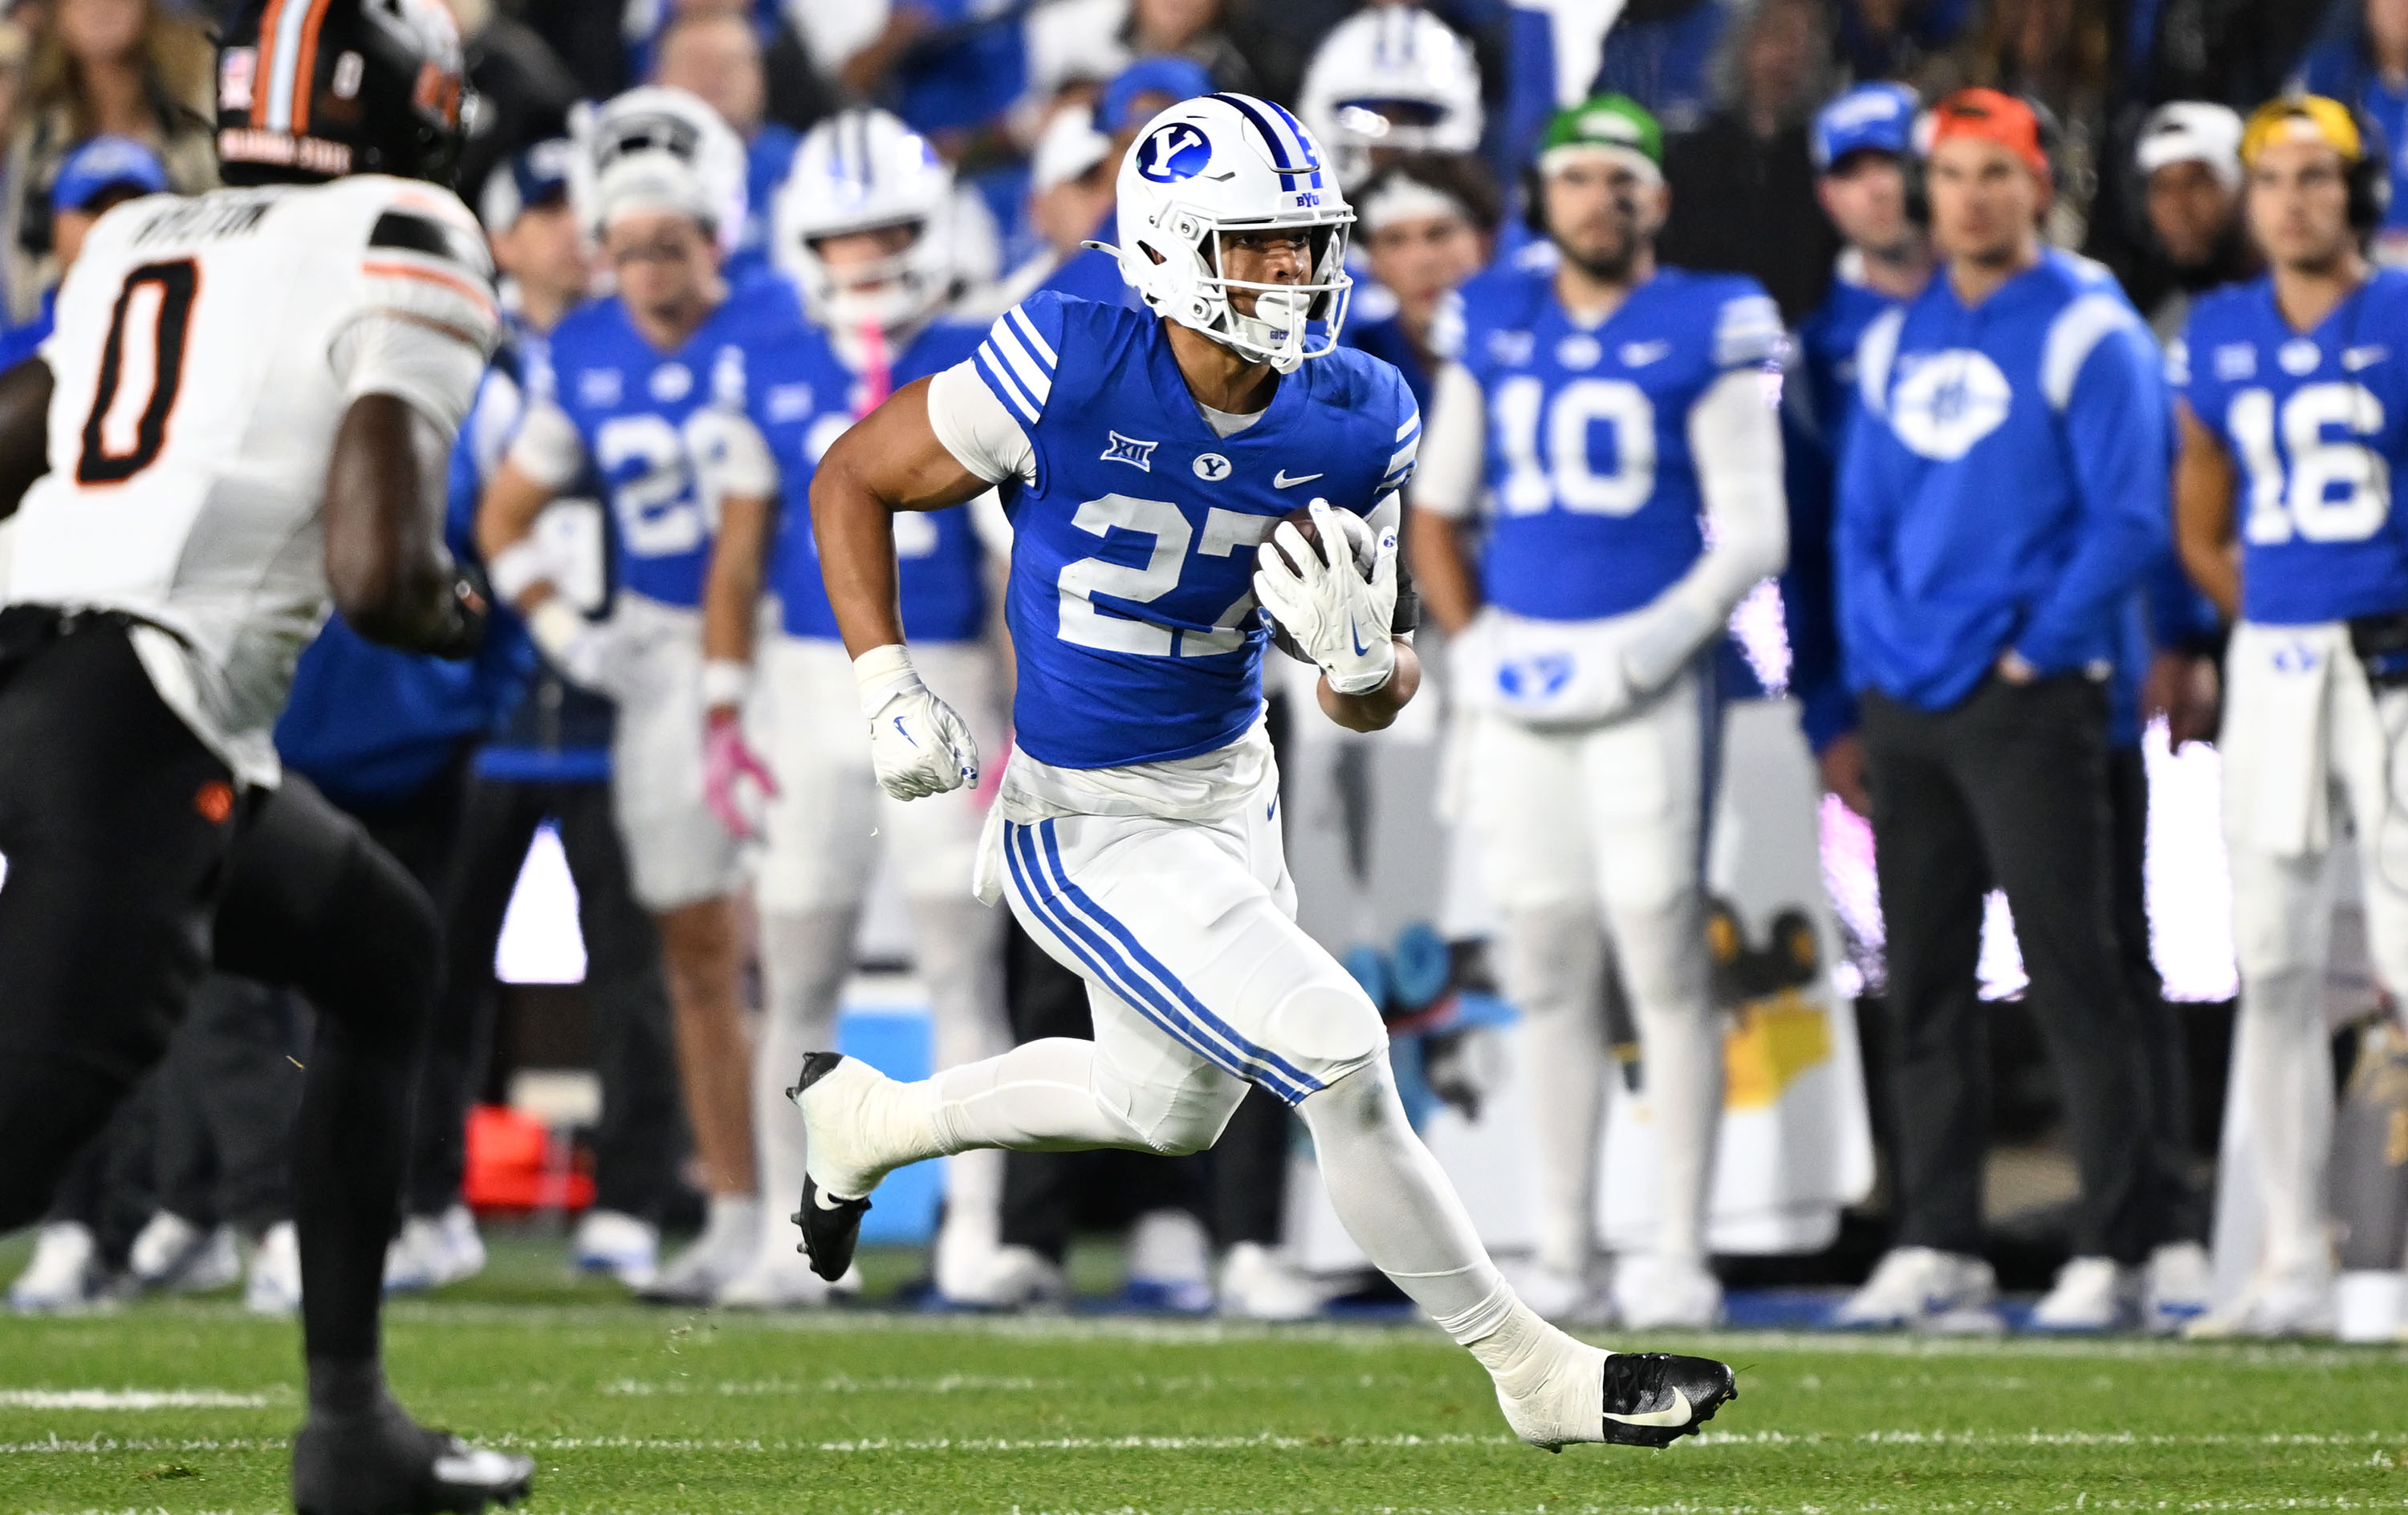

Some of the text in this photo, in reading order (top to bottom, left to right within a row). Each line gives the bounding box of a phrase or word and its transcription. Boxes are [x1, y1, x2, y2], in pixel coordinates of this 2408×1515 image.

[1147, 126, 1203, 177] Y
[1296, 192, 1320, 208] BYU
[76, 257, 201, 486] 0
[1104, 433, 1154, 469] XII
[1202, 457, 1226, 477] Y
[1498, 376, 1657, 518] 10
[2228, 384, 2390, 544] 16
[1057, 493, 1284, 658] 27
